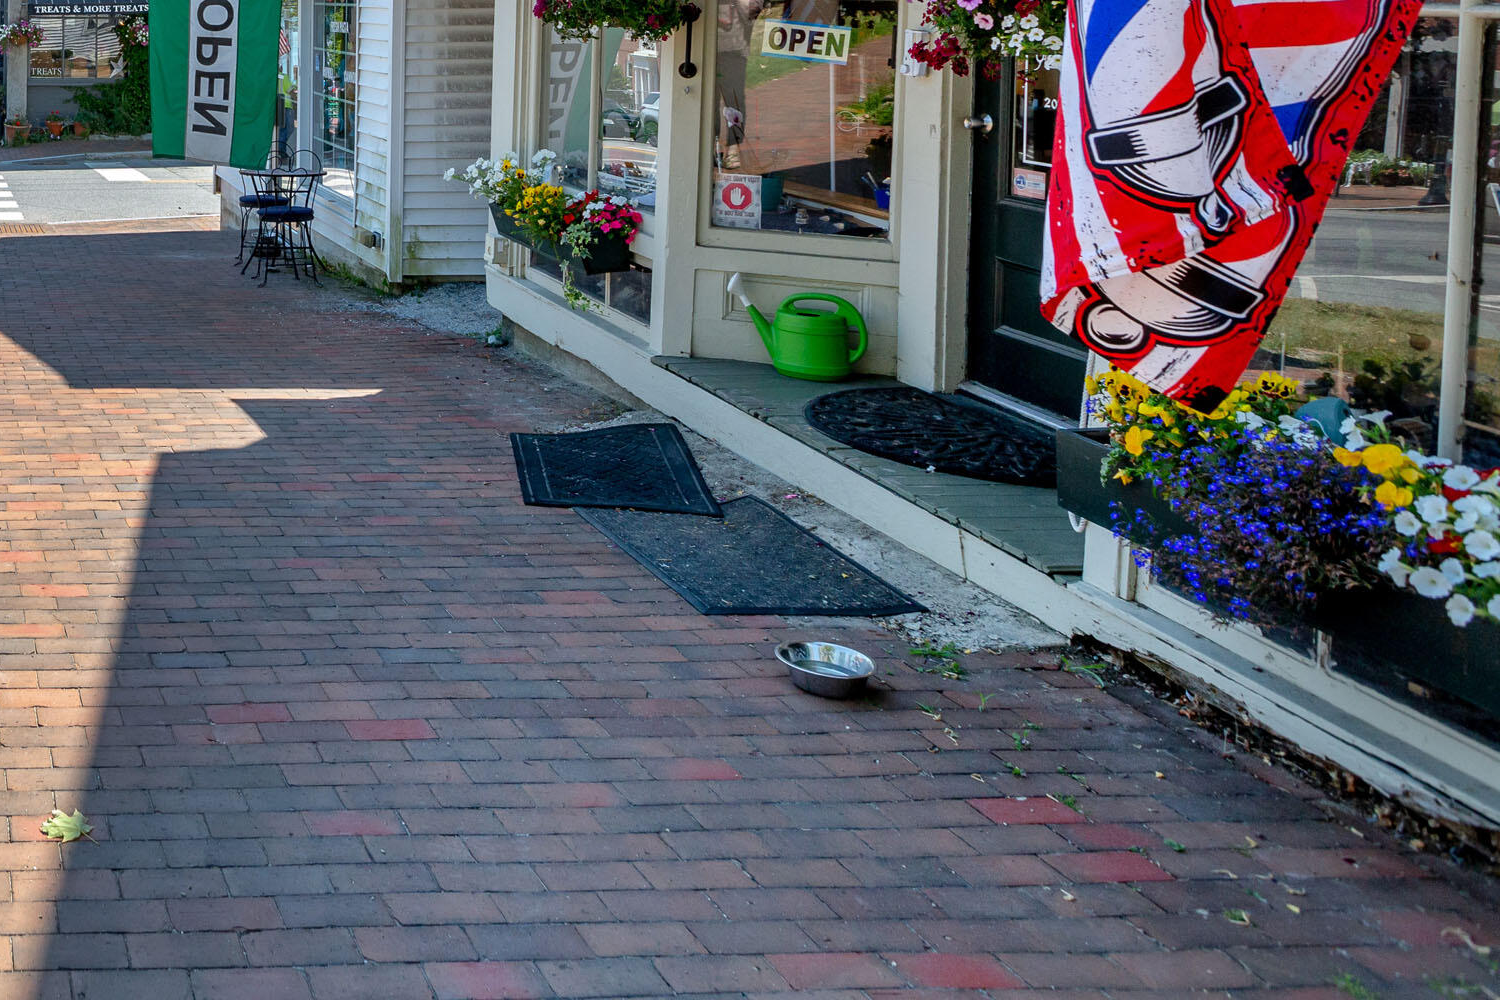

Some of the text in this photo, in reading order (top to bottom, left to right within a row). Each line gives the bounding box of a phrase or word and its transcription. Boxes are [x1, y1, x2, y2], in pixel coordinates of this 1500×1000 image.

[34, 3, 149, 14] TREATS & MORE TREATS
[768, 26, 846, 58] OPEN
[31, 67, 62, 76] TREATS
